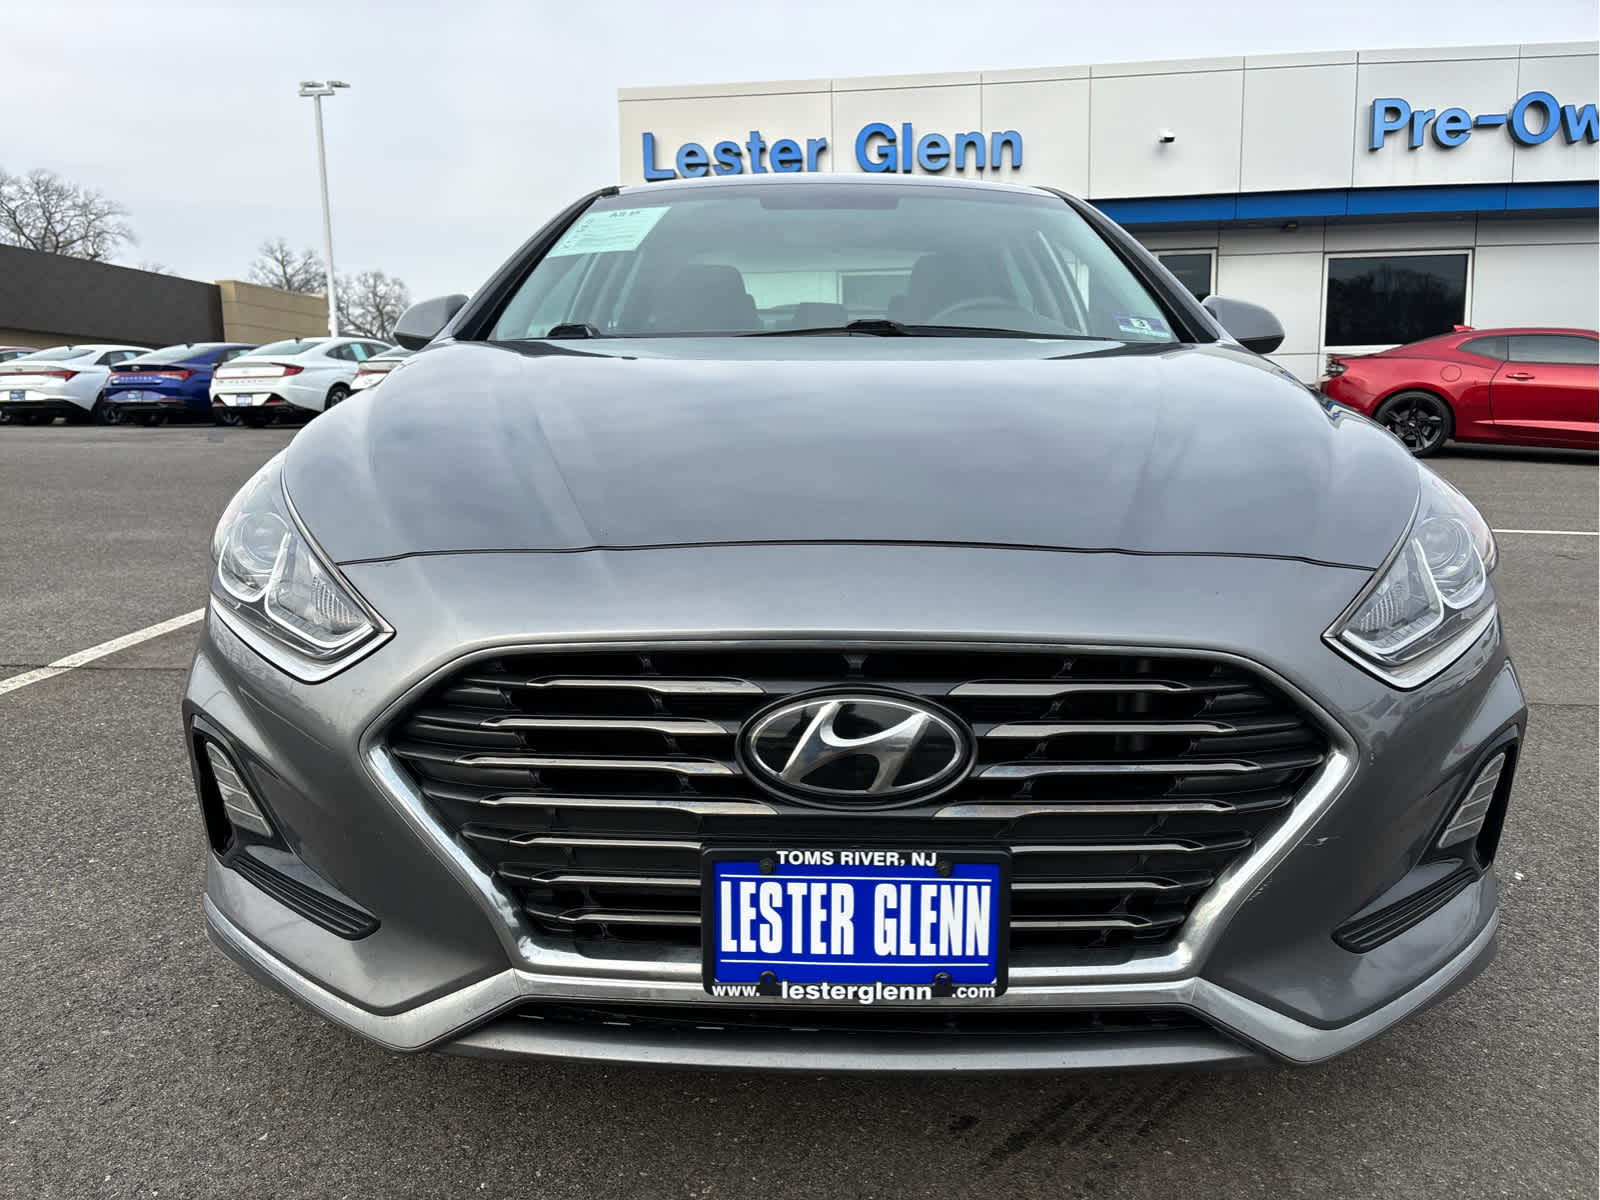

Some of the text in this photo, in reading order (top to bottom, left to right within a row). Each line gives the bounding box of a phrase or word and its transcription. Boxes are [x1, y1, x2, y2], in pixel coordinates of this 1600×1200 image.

[642, 122, 1024, 181] Lester Glenn
[776, 850, 938, 867] TOMS RIVER, NJ
[720, 881, 992, 957] LESTER GLENN
[711, 985, 760, 997] www.
[782, 981, 932, 1005] lesterglenn
